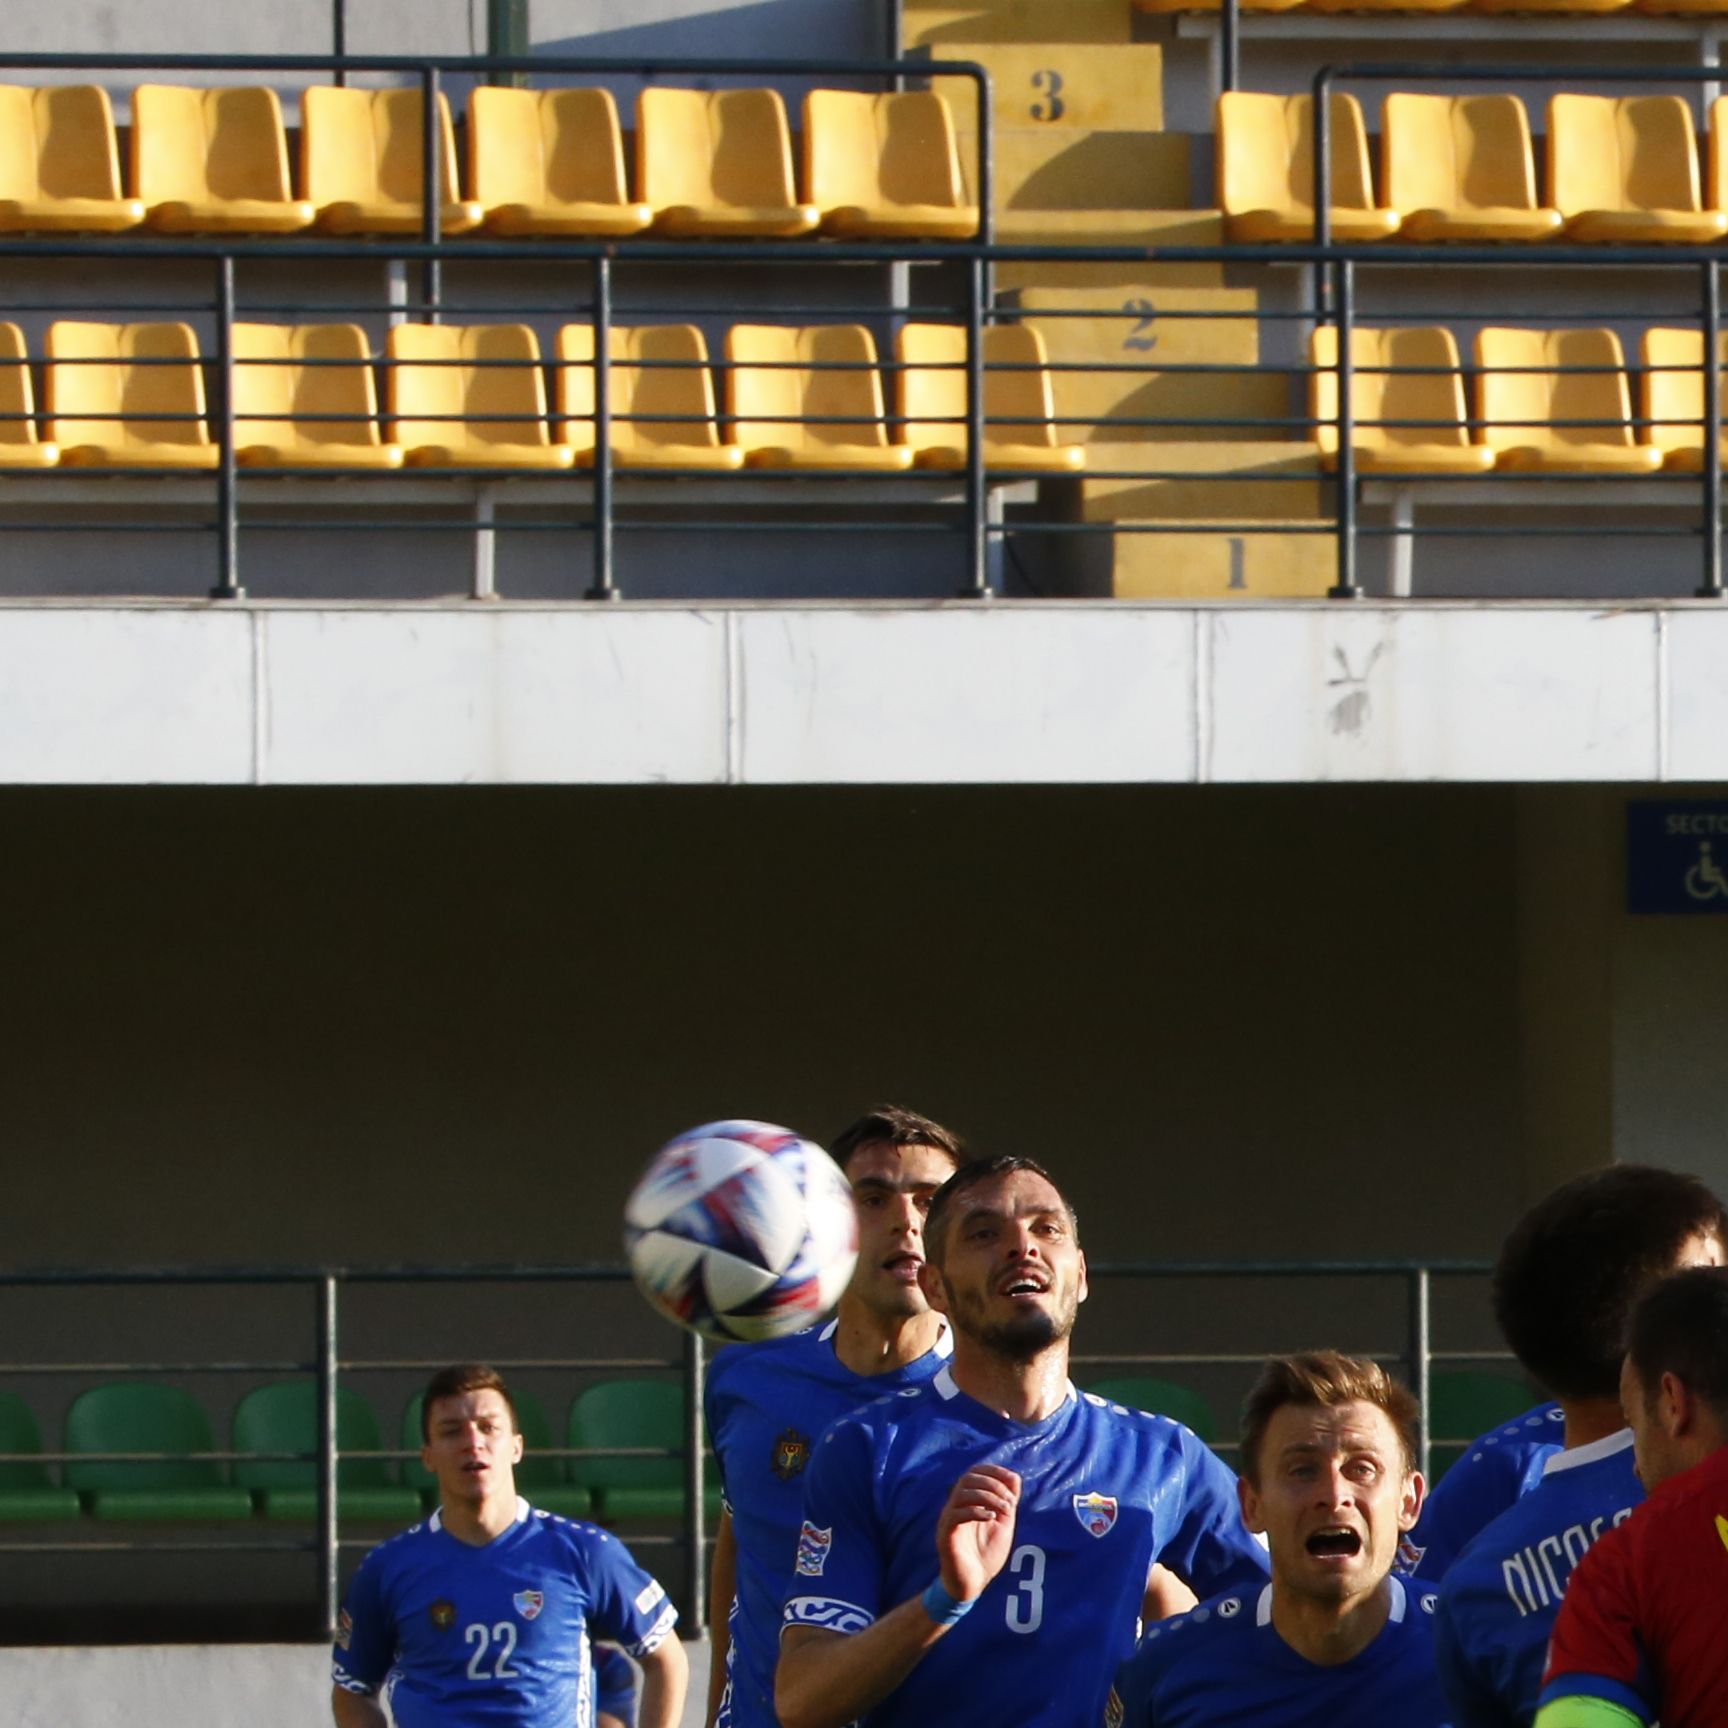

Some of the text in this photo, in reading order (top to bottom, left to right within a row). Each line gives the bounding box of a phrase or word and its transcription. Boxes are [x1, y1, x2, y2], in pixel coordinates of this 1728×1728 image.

[1029, 69, 1066, 122] 3
[1121, 299, 1158, 352] 2
[1226, 536, 1248, 590] 1
[1005, 1544, 1046, 1634] 3
[465, 1621, 518, 1681] 22
